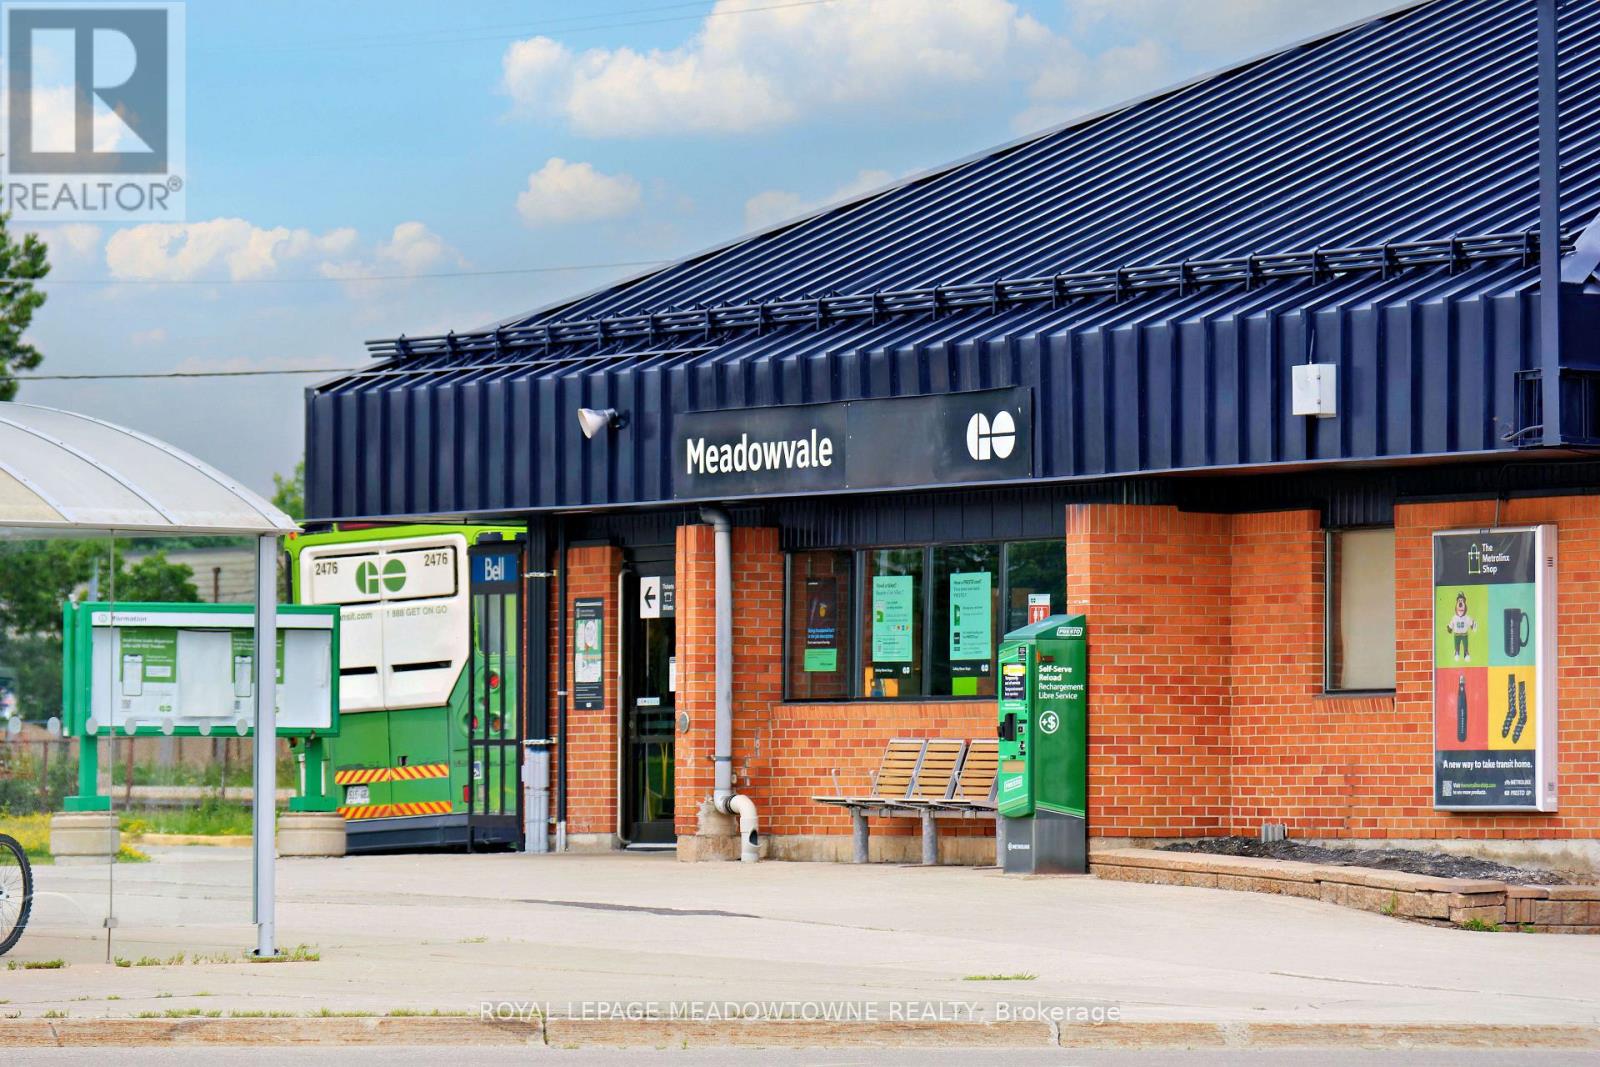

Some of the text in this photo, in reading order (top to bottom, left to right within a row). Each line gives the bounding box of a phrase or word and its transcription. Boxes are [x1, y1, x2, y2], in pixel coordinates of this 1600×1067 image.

[687, 428, 833, 474] Meadowvale
[1482, 543, 1493, 552] The
[423, 553, 448, 567] 2476
[1482, 553, 1510, 563] Metrolinx
[315, 561, 339, 576] 2476
[484, 556, 505, 581] Bell
[1482, 564, 1498, 575] Shop
[391, 608, 405, 618] 888
[406, 607, 421, 617] GET
[422, 605, 434, 616] ON
[435, 604, 448, 615] GO
[1038, 665, 1073, 673] Self-Serve
[1038, 674, 1062, 682] Reload
[1038, 683, 1084, 692] Rechargement
[1038, 692, 1078, 700] Libre Service
[1443, 758, 1533, 770] A new way to take transit home.
